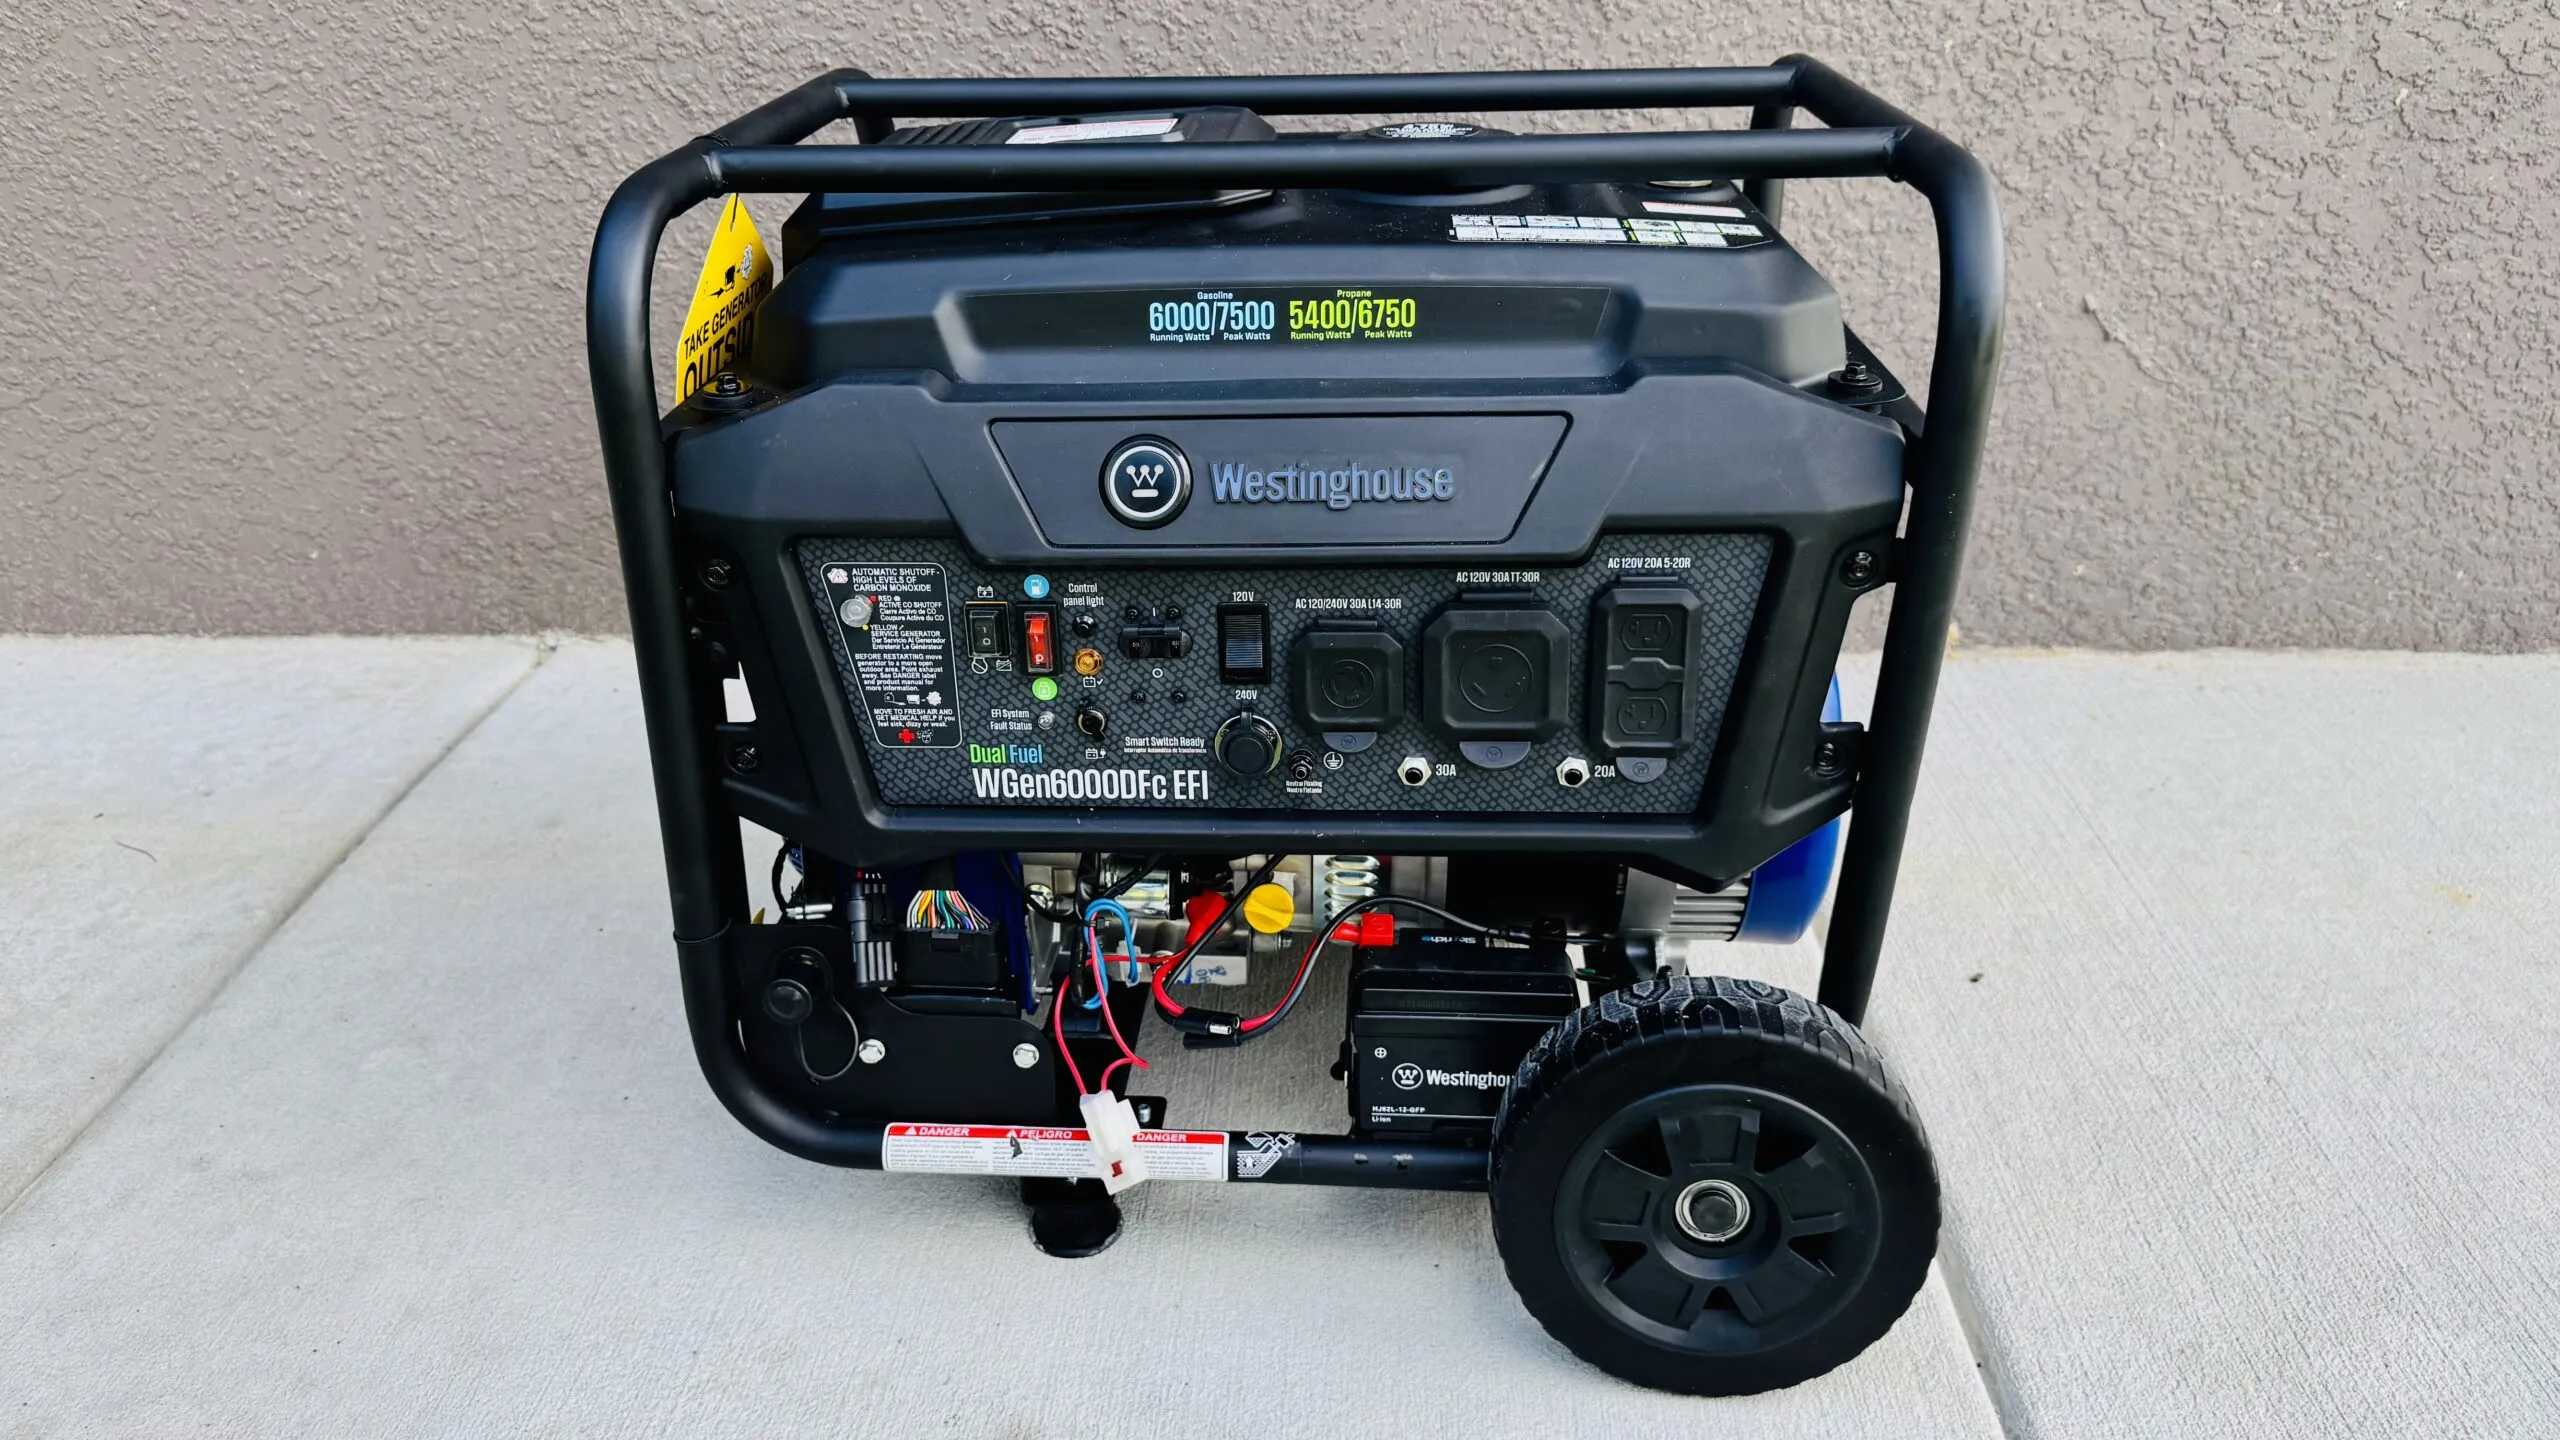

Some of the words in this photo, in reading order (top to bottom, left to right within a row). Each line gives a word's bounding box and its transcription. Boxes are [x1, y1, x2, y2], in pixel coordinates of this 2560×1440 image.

[1197, 291, 1233, 300] Gasoline
[1337, 289, 1372, 299] Propane
[684, 320, 709, 360] TAKE
[712, 272, 768, 334] GENERATOR
[1150, 300, 1275, 336] 6000/7500
[1289, 298, 1416, 334] 5400/6750
[1150, 333, 1184, 343] Running
[1185, 333, 1211, 341] Watts
[1223, 332, 1244, 341] Peak
[1245, 332, 1271, 341] Watts
[1290, 331, 1324, 341] Running
[1325, 331, 1351, 340] Watts
[1365, 330, 1385, 339] Peak
[1386, 330, 1412, 338] Watts
[1210, 461, 1455, 510] Westinghouse
[1607, 557, 1620, 569] AC
[1621, 557, 1644, 569] 120V
[1644, 557, 1662, 569] 20A
[1663, 557, 1691, 569] 5-20R
[852, 568, 898, 576] AUTOMATIC
[1456, 572, 1469, 583] AC
[1469, 572, 1491, 583] 120V
[1492, 572, 1509, 583] 30A
[1510, 572, 1540, 583] TT-30R
[853, 576, 874, 584] HIGH
[875, 576, 905, 584] LEVELS
[906, 576, 917, 584] OF
[853, 584, 888, 592] CARBON
[890, 584, 932, 592] MONOXIDE
[1068, 583, 1098, 593] Control
[1063, 597, 1085, 608] panel
[1086, 596, 1105, 608] light
[1232, 591, 1255, 602] 120V
[1295, 598, 1307, 609] AC
[1308, 598, 1348, 610] 120/240V
[1349, 598, 1367, 609] 30A
[1368, 599, 1402, 609] L14-30R
[876, 679, 900, 687] product
[1235, 689, 1258, 700] 240V
[990, 709, 1001, 719] EFI
[1002, 709, 1030, 720] System
[990, 721, 1009, 731] Fault
[1009, 721, 1033, 731] Status
[1125, 736, 1150, 747] Smart
[1150, 736, 1179, 747] Switch
[1180, 737, 1205, 748] Ready
[969, 744, 1007, 764] Dual
[1009, 744, 1043, 764] Fuel
[1435, 764, 1457, 777] 30A
[1594, 765, 1616, 778] 20A
[972, 767, 1167, 800] WGen6000DFc
[1173, 769, 1209, 801] EFI
[919, 1127, 970, 1137] DANGER
[1019, 1129, 1073, 1140] PELIGRO
[1136, 1133, 1187, 1143] DANGER
